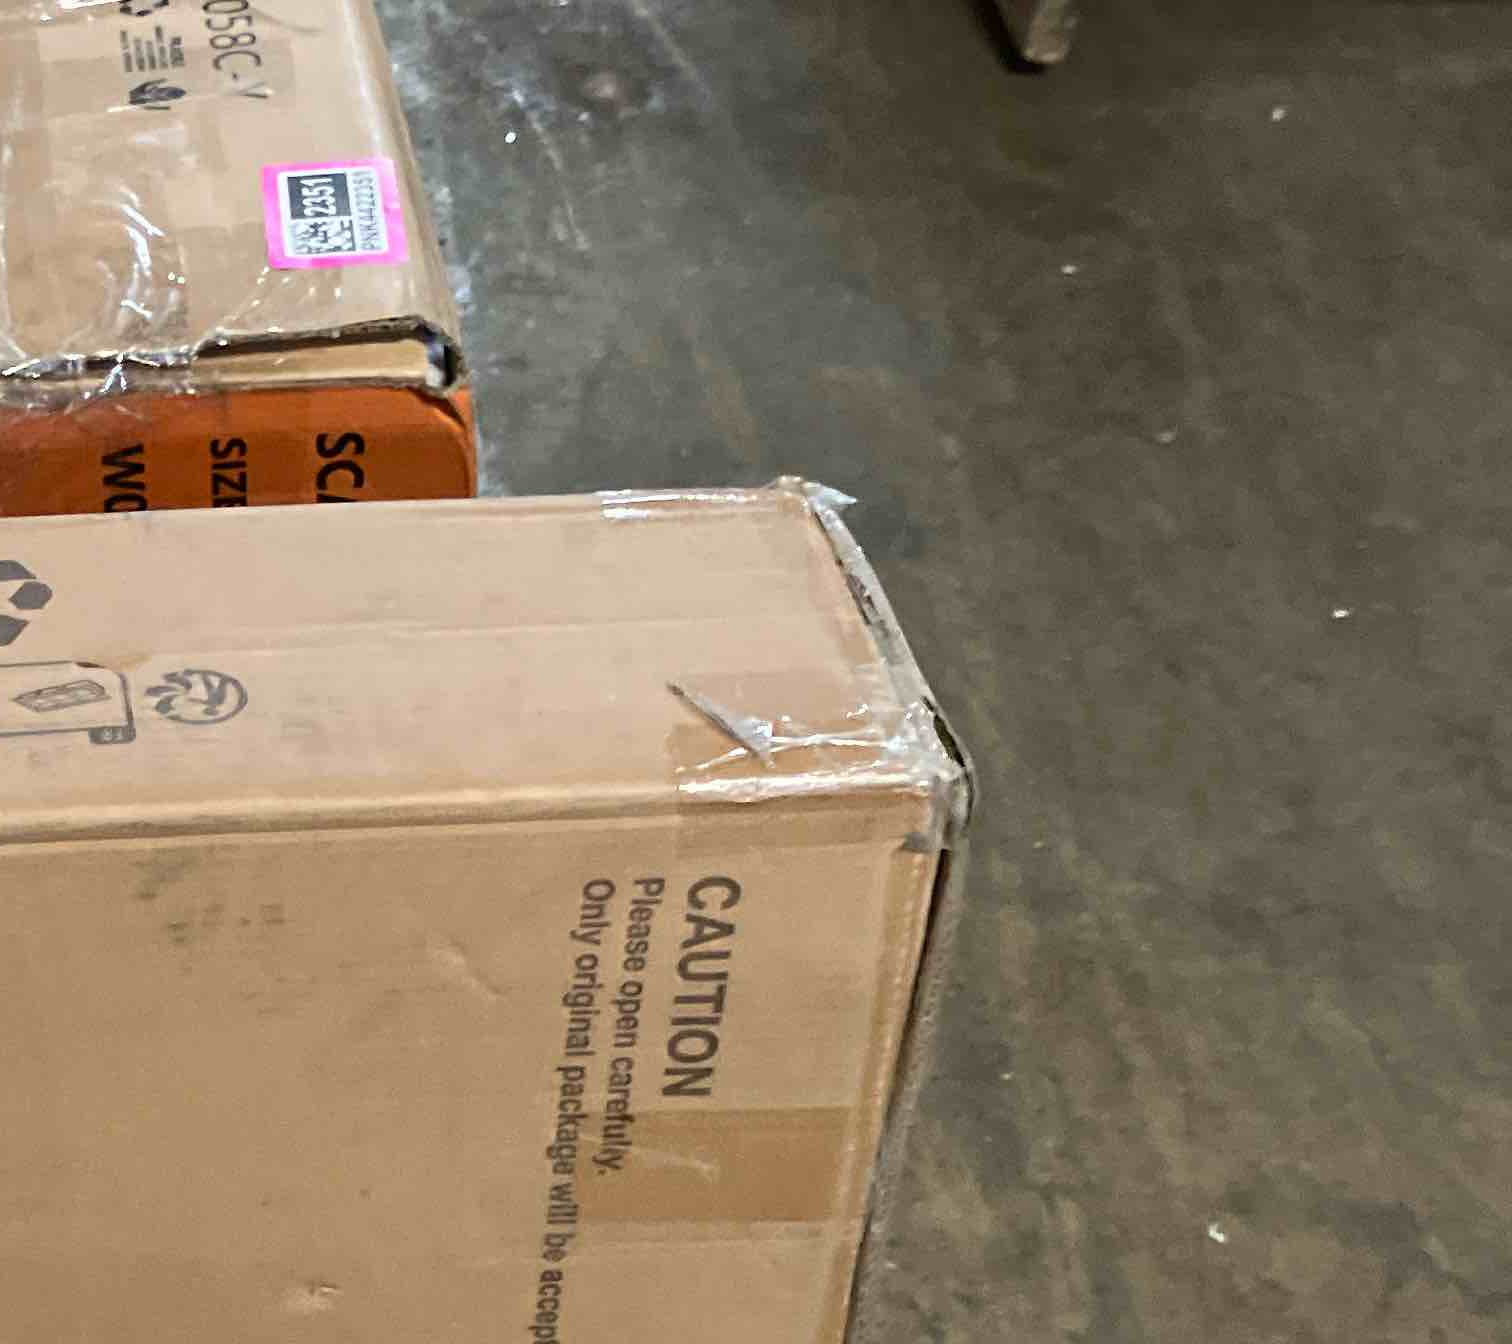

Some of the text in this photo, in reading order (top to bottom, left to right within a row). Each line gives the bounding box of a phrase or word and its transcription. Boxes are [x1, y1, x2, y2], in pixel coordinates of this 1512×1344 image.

[300, 177, 336, 217] 2351
[315, 432, 365, 503] SC
[569, 877, 616, 946] Only
[562, 953, 605, 1056] original
[662, 875, 742, 1096] CAUTION
[591, 877, 666, 1176] Please open carefully.
[546, 1065, 589, 1175] package
[546, 1182, 580, 1225] will
[541, 1231, 577, 1263] be
